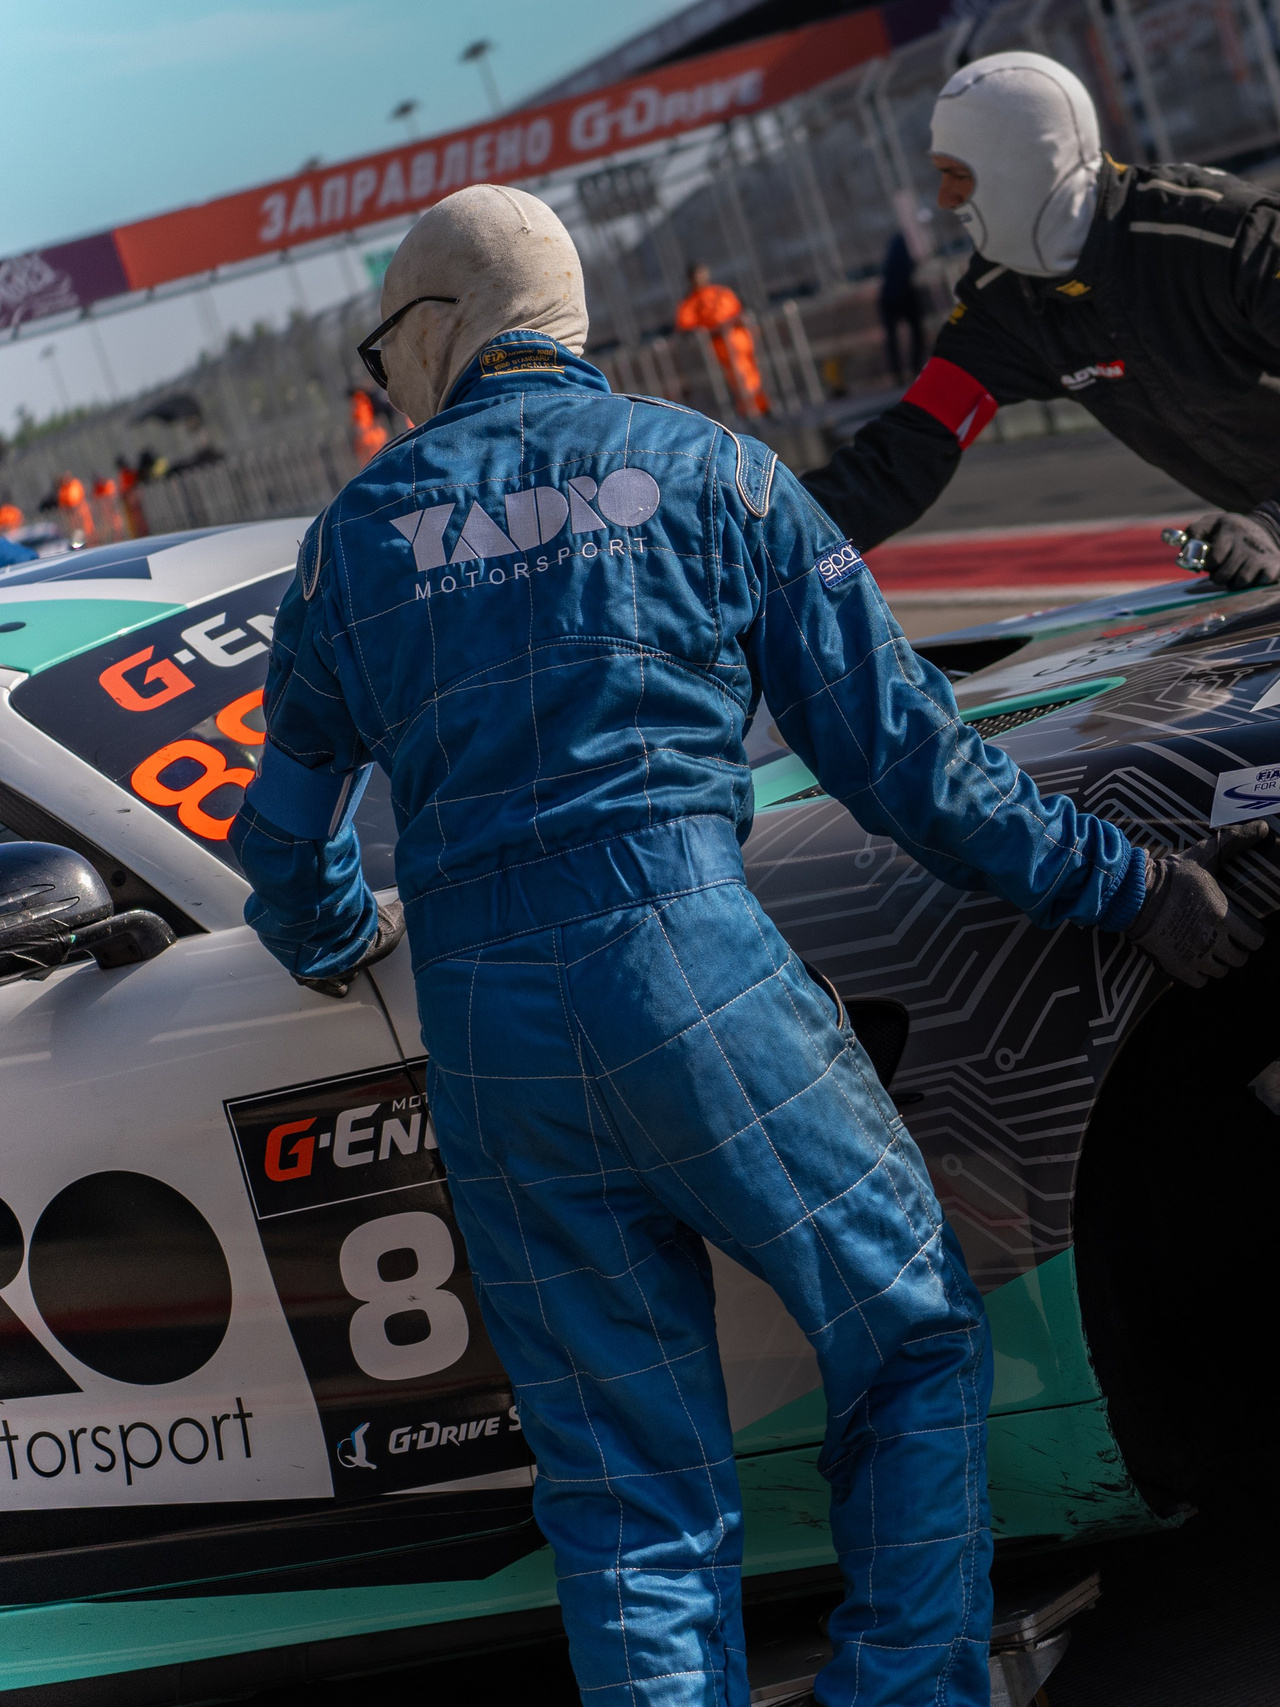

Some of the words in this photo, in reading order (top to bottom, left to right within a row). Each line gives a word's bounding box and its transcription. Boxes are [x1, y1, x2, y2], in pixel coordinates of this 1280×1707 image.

[258, 117, 552, 241] ЗАПРАВЛЕНО
[389, 467, 660, 572] YADRO
[414, 536, 648, 600] MOTORSPORT
[820, 544, 857, 577] spa
[1254, 781, 1276, 792] FOR
